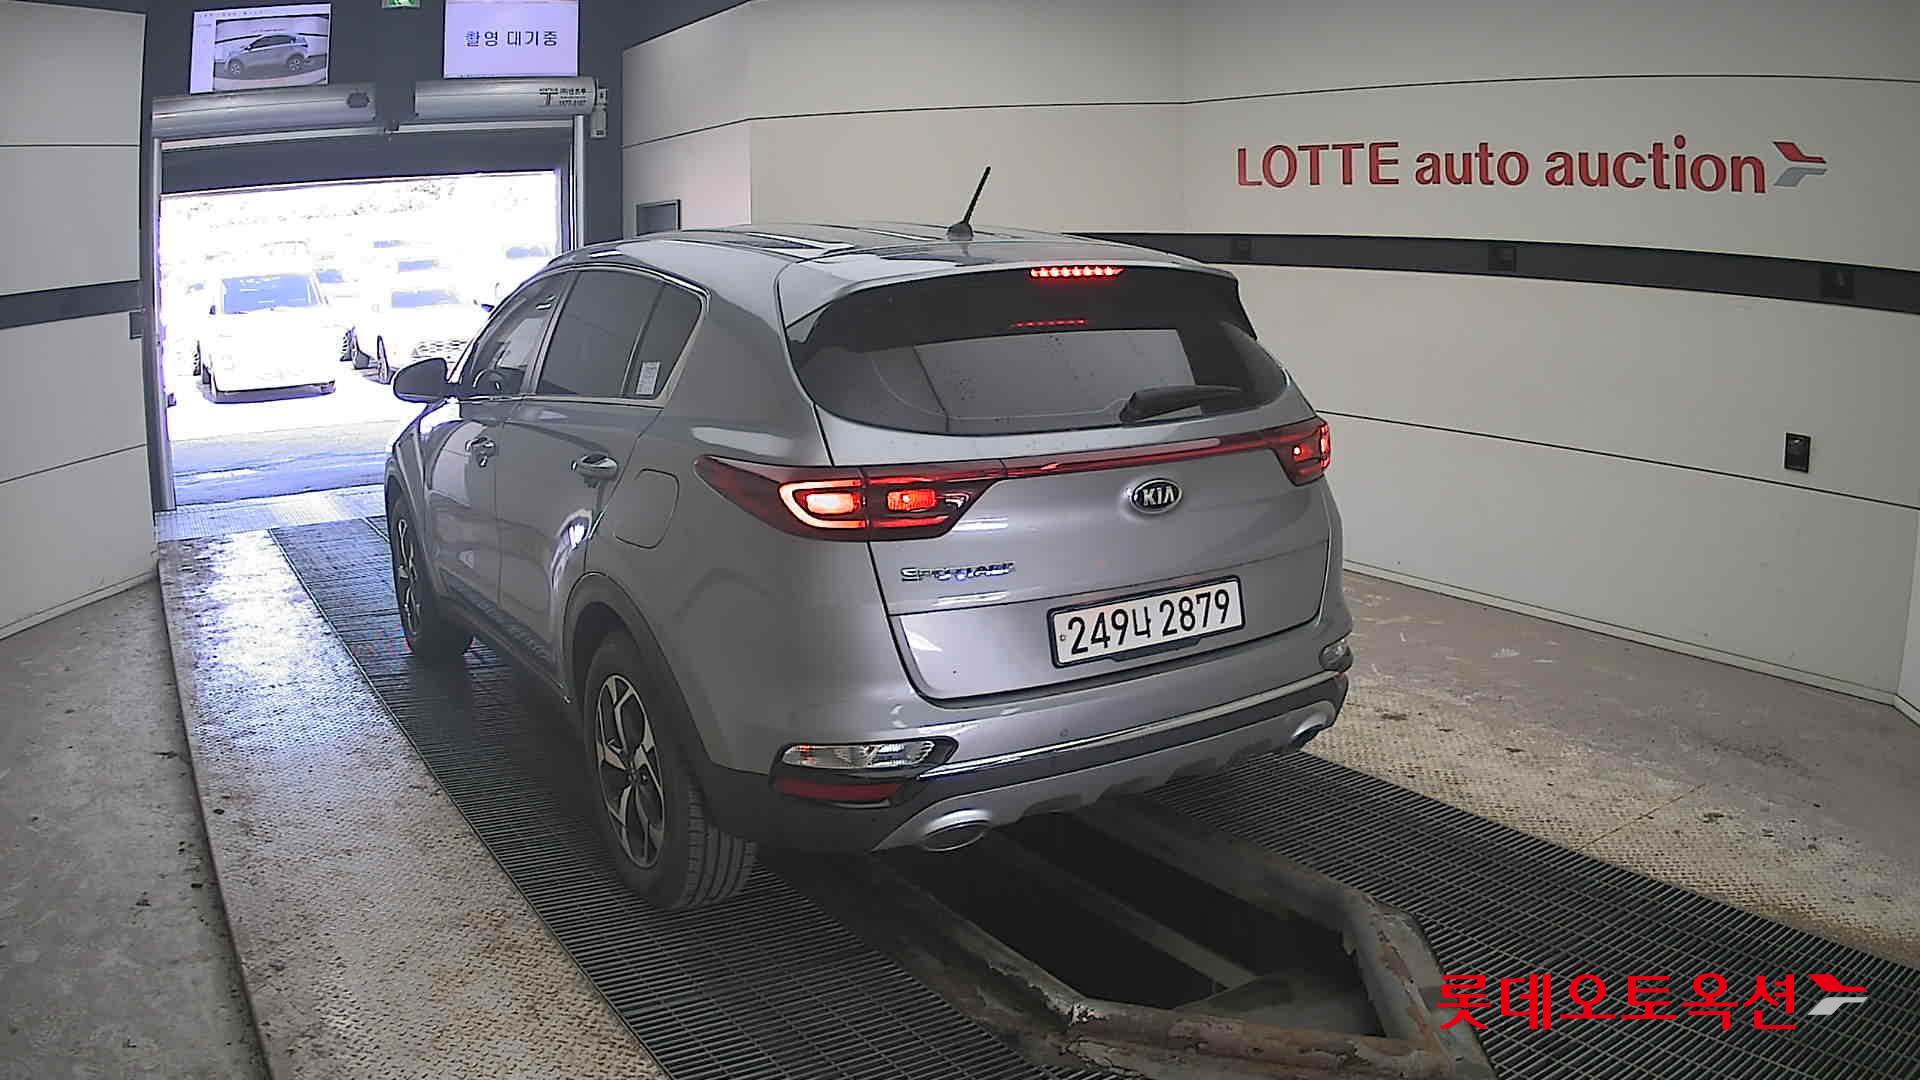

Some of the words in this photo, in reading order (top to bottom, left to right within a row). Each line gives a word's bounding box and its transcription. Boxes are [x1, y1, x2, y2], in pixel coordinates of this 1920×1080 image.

[465, 31, 498, 47] 촬영
[507, 30, 558, 47] 대기중
[1237, 141, 1399, 188] LOTTE
[1415, 142, 1529, 187] auto
[1544, 135, 1767, 194] auction
[1142, 485, 1175, 506] KIA
[1067, 606, 1152, 656] 249나
[1159, 588, 1230, 638] 2879
